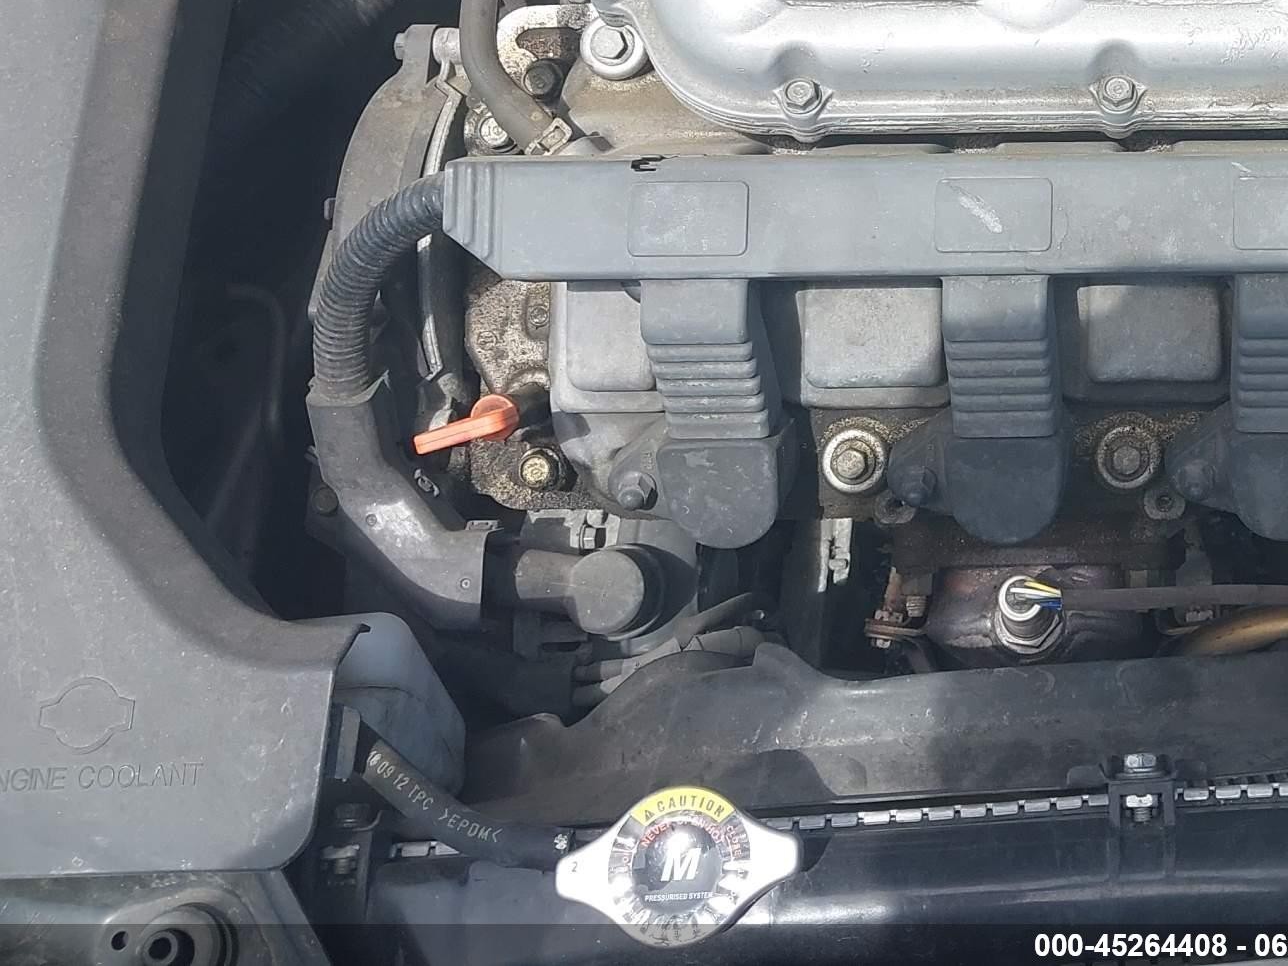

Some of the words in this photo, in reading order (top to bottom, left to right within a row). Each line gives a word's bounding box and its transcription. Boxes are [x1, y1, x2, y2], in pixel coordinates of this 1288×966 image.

[0, 767, 68, 793] NGINE
[78, 763, 205, 790] COOLANT
[408, 784, 434, 811] TPC
[657, 795, 725, 818] CAUTION
[644, 893, 688, 902] PRESSURISED
[688, 891, 714, 900] SYSTEM
